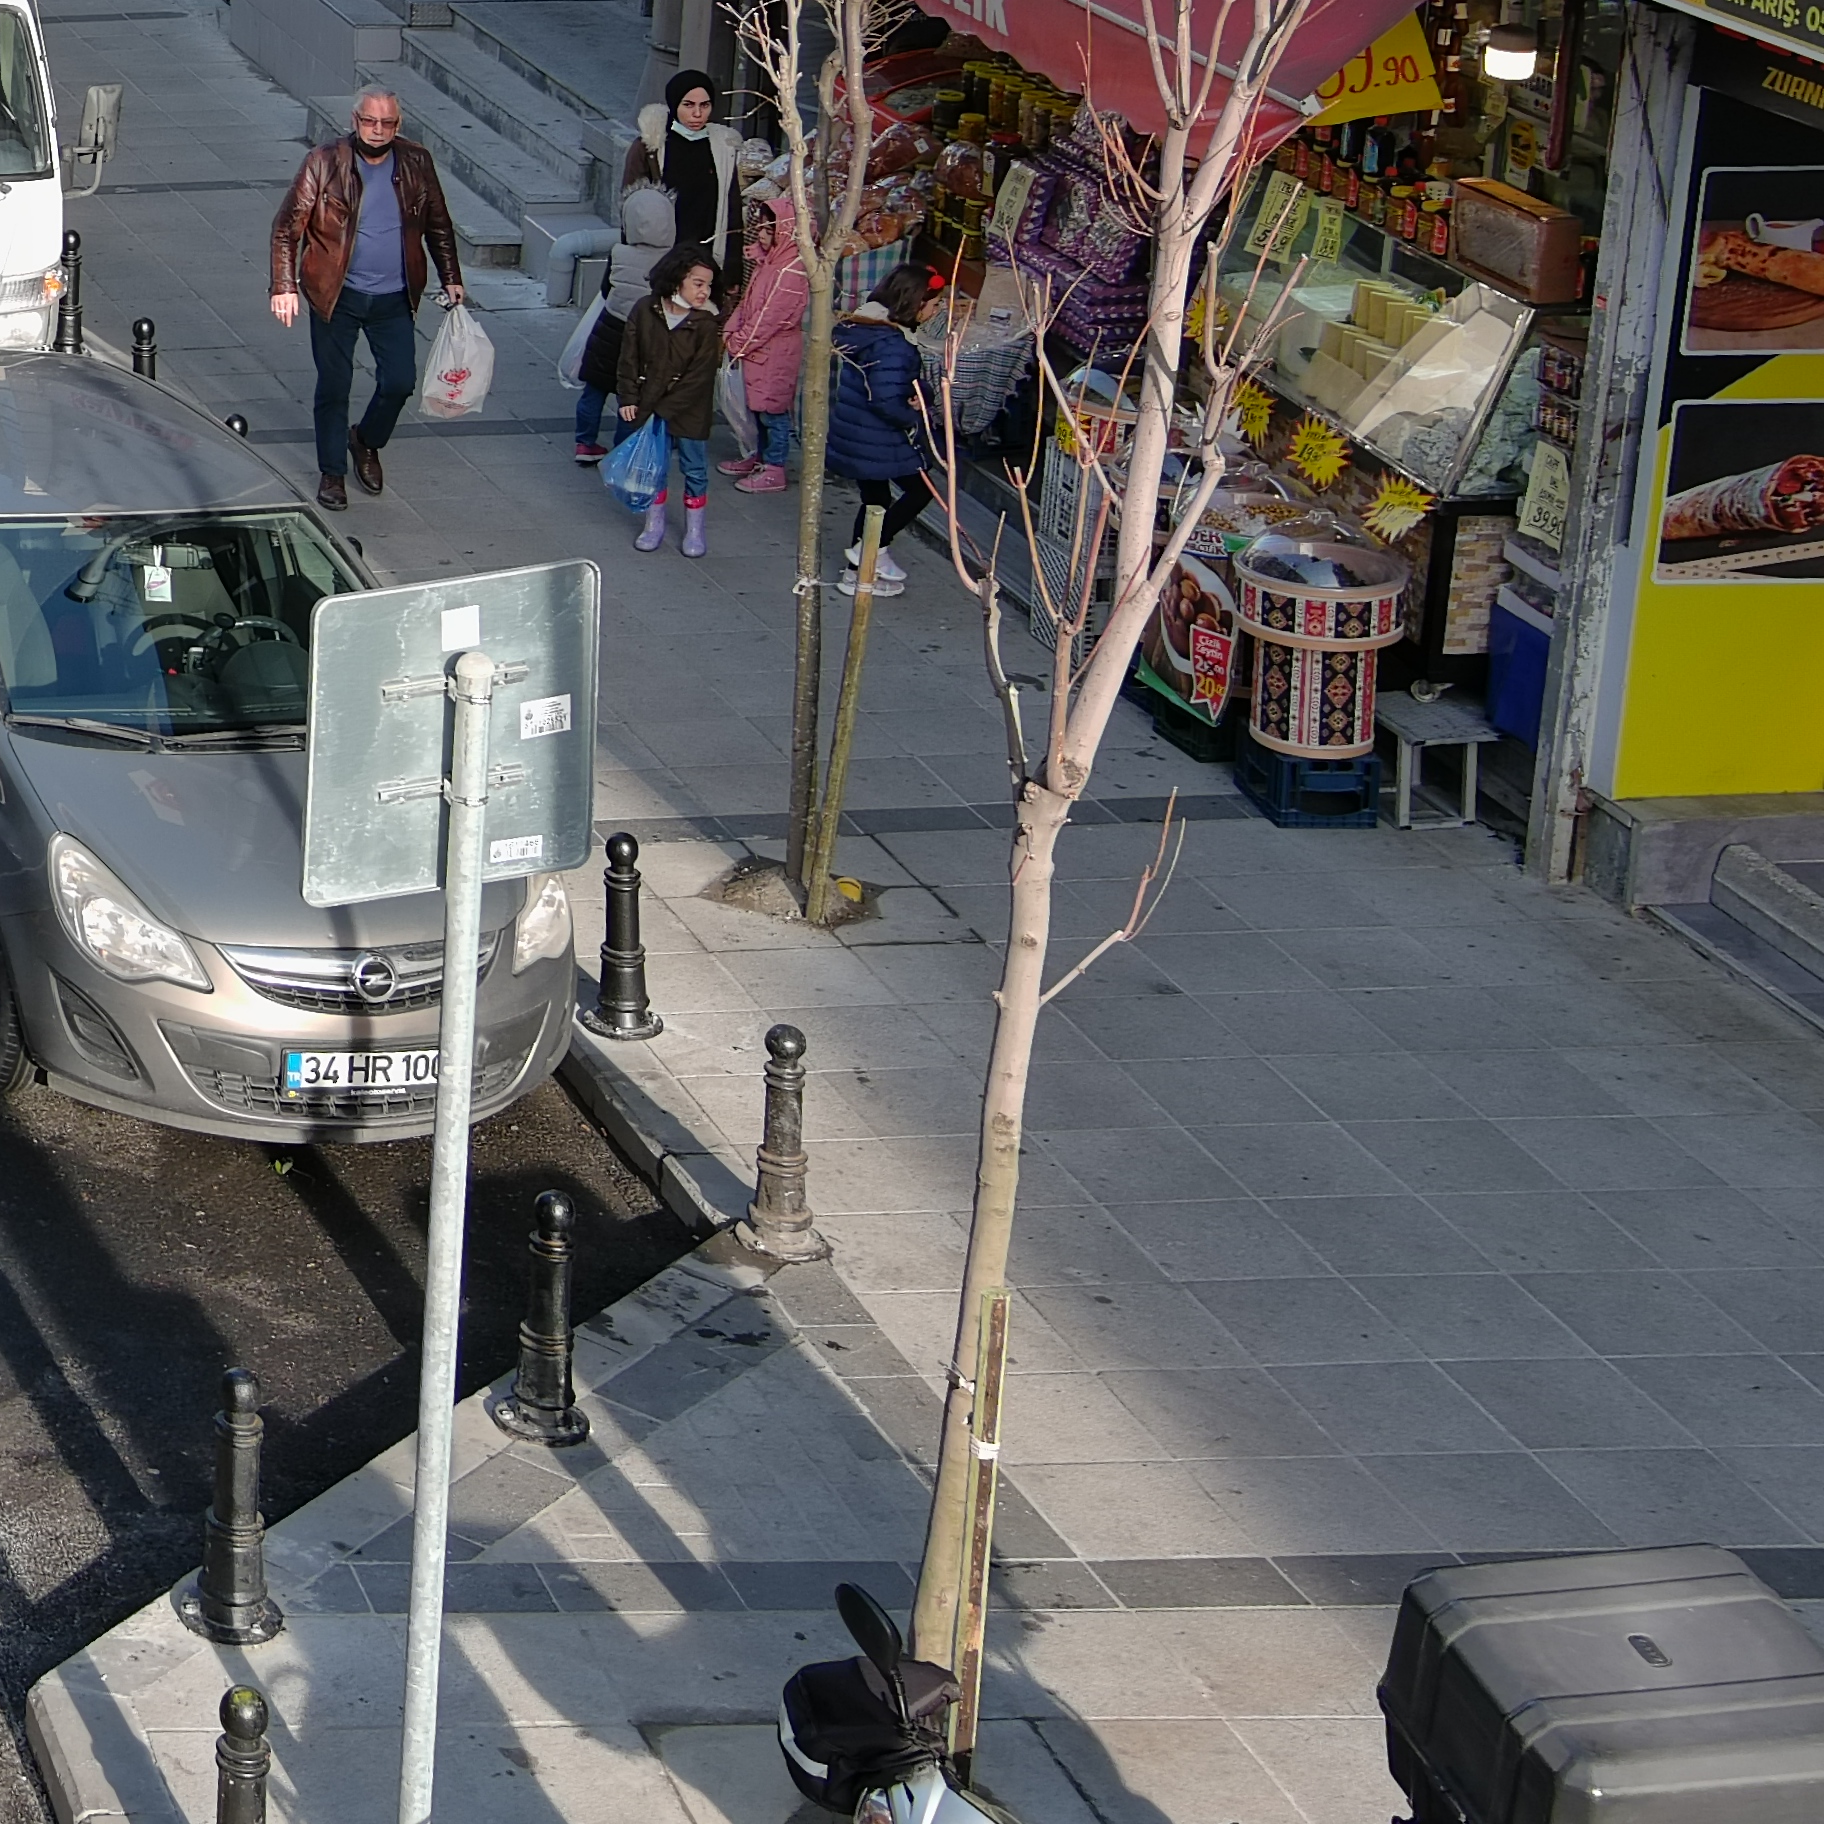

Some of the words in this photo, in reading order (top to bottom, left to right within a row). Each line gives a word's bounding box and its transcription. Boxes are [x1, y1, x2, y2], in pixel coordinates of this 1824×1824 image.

[287, 1071, 301, 1082] TR
[304, 1055, 340, 1084] 34
[347, 1054, 394, 1084] HR
